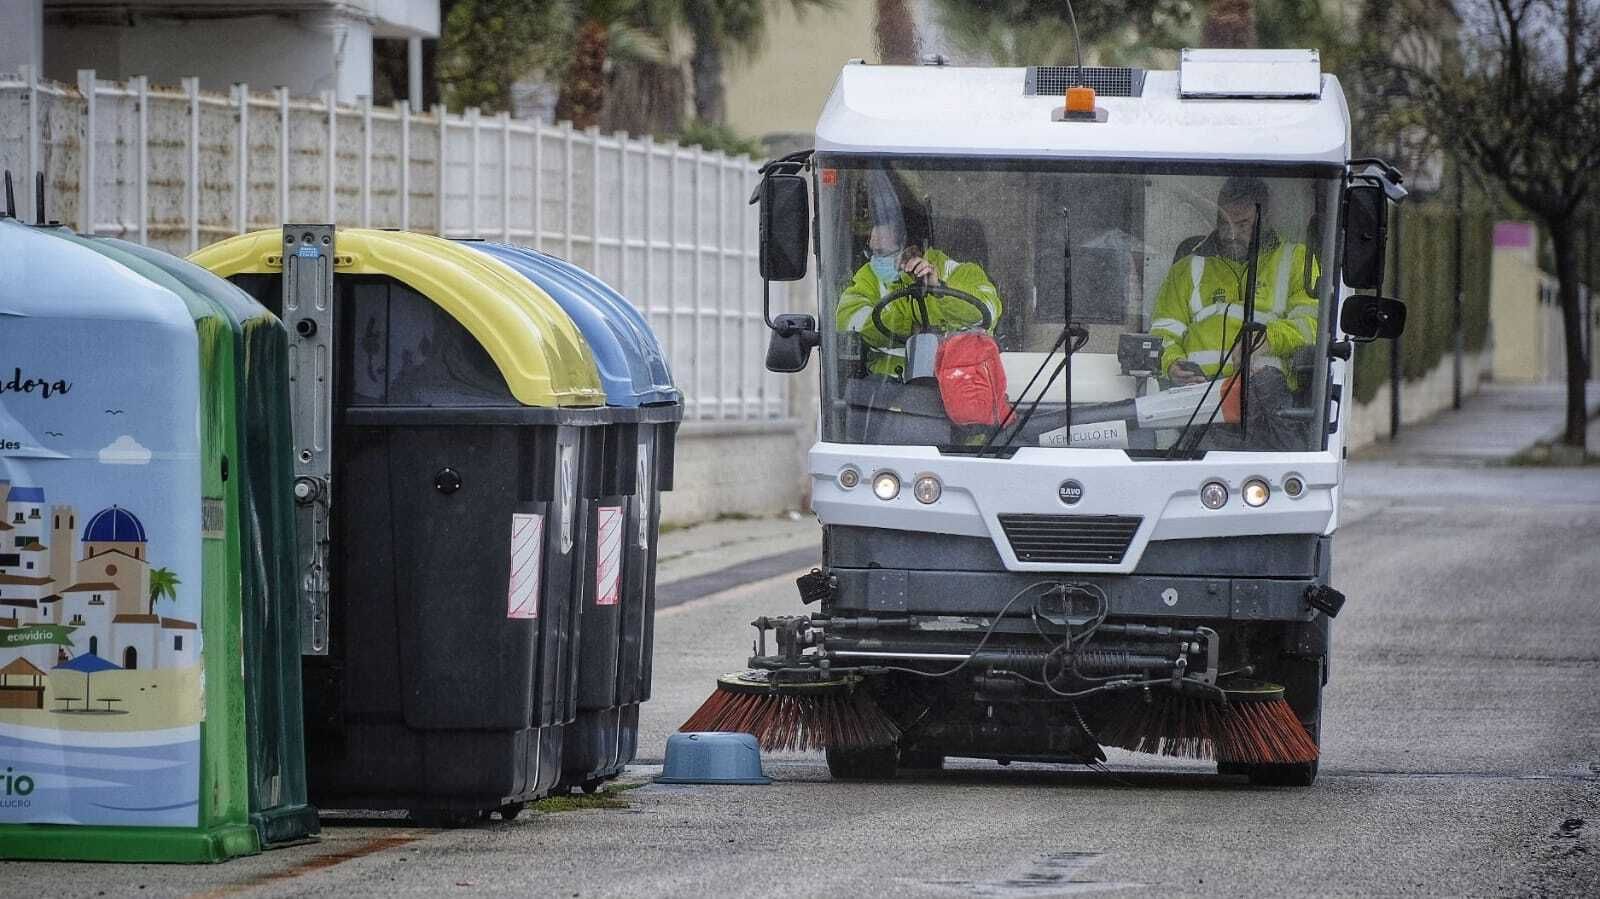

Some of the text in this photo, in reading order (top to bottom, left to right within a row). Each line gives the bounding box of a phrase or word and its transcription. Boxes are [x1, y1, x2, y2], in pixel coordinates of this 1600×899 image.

[0, 367, 72, 399] dora
[1103, 428, 1118, 441] EN
[7, 630, 54, 642] ecovidrio
